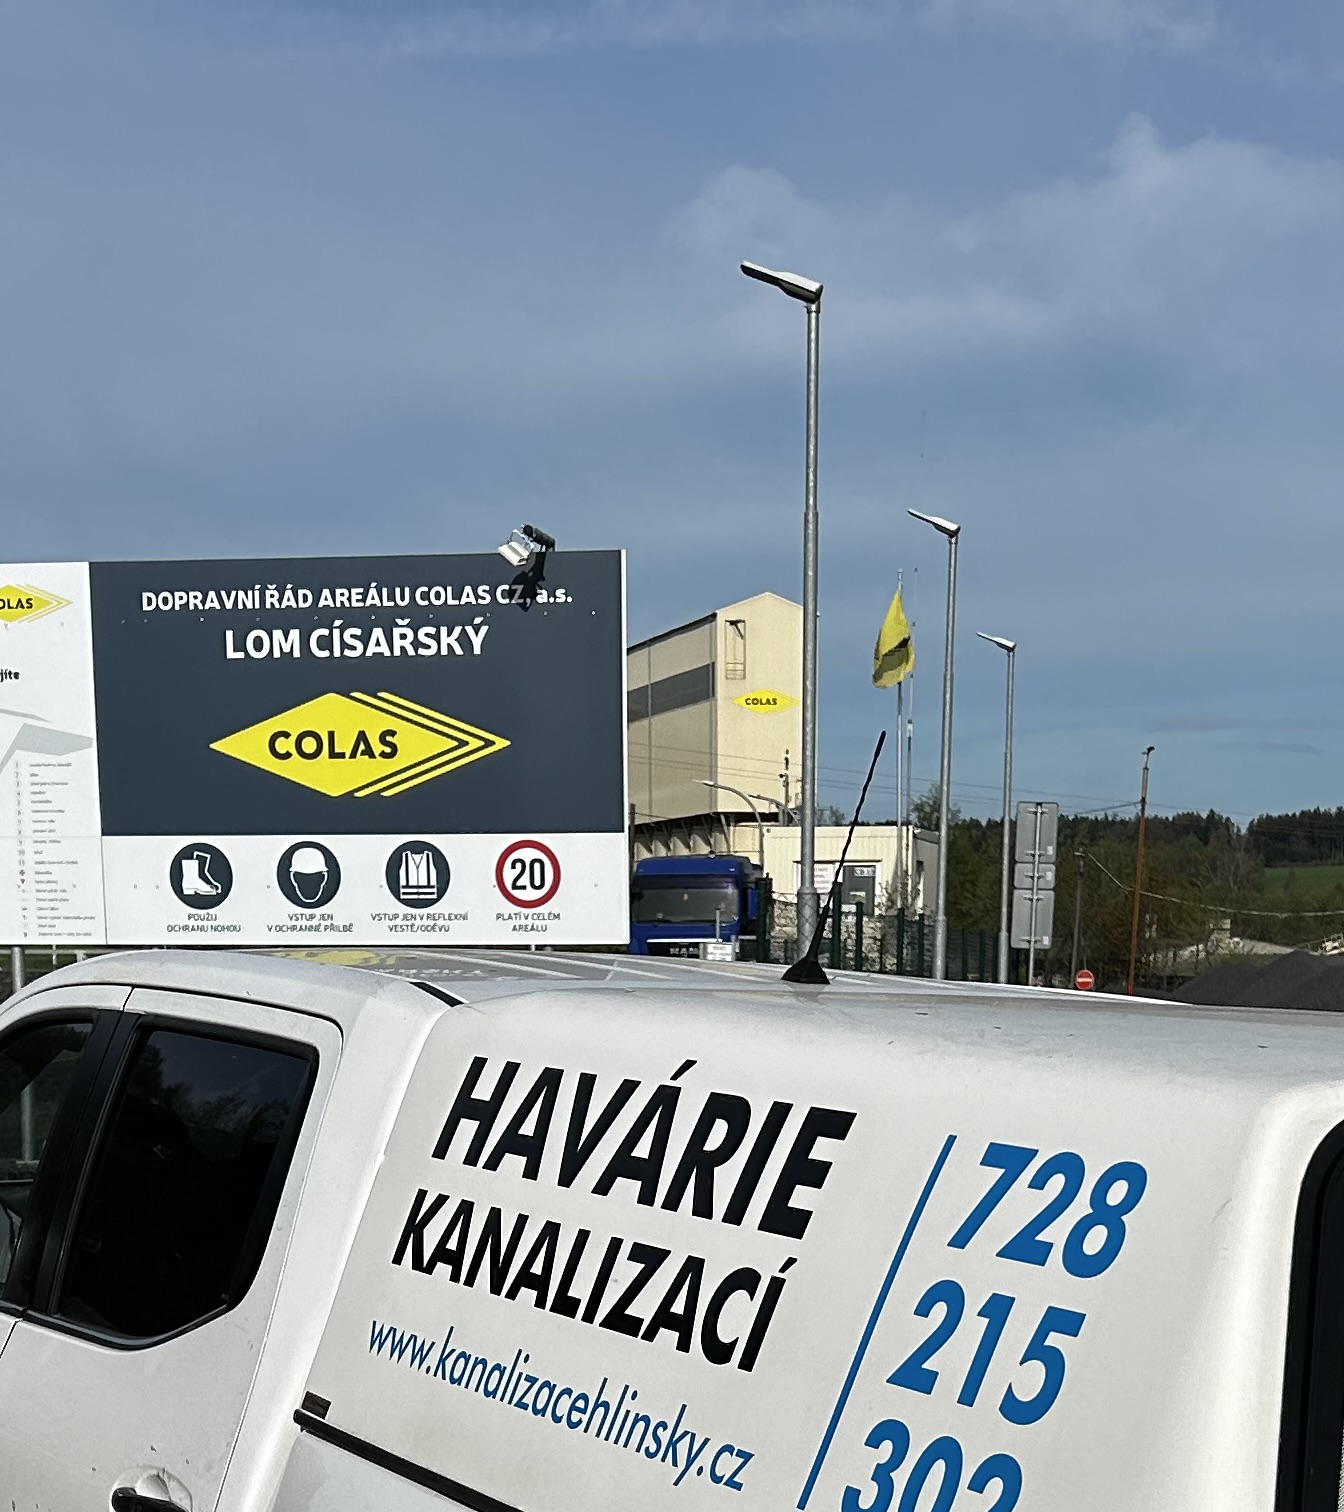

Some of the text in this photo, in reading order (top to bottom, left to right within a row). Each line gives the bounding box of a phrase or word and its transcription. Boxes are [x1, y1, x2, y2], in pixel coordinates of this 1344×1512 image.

[142, 585, 262, 611] DOPRAVNÍ
[266, 583, 313, 609] ŘÁD
[318, 582, 410, 608] AREÁLU
[415, 584, 491, 606] COLAS
[536, 588, 572, 603] a.s.
[225, 617, 489, 659] LOM CÍSAŘSKÝ
[745, 697, 777, 705] COLAS
[268, 730, 398, 760] COLAS
[510, 858, 546, 891] 20
[267, 924, 274, 932] V
[288, 912, 334, 921] VSTUP JEN
[370, 913, 399, 921] VSTUP
[401, 912, 416, 921] JEN
[418, 912, 425, 920] V
[496, 911, 561, 921] PLATÍ V CELÉM
[511, 922, 548, 932] AREÁLU
[431, 1056, 858, 1240] HAVÁRIE
[946, 1141, 1147, 1279] 728
[391, 1187, 798, 1373] KANALIZACÍ
[886, 1279, 1086, 1427] 215
[367, 1319, 756, 1493] www.kanalizacehlinsky.cz
